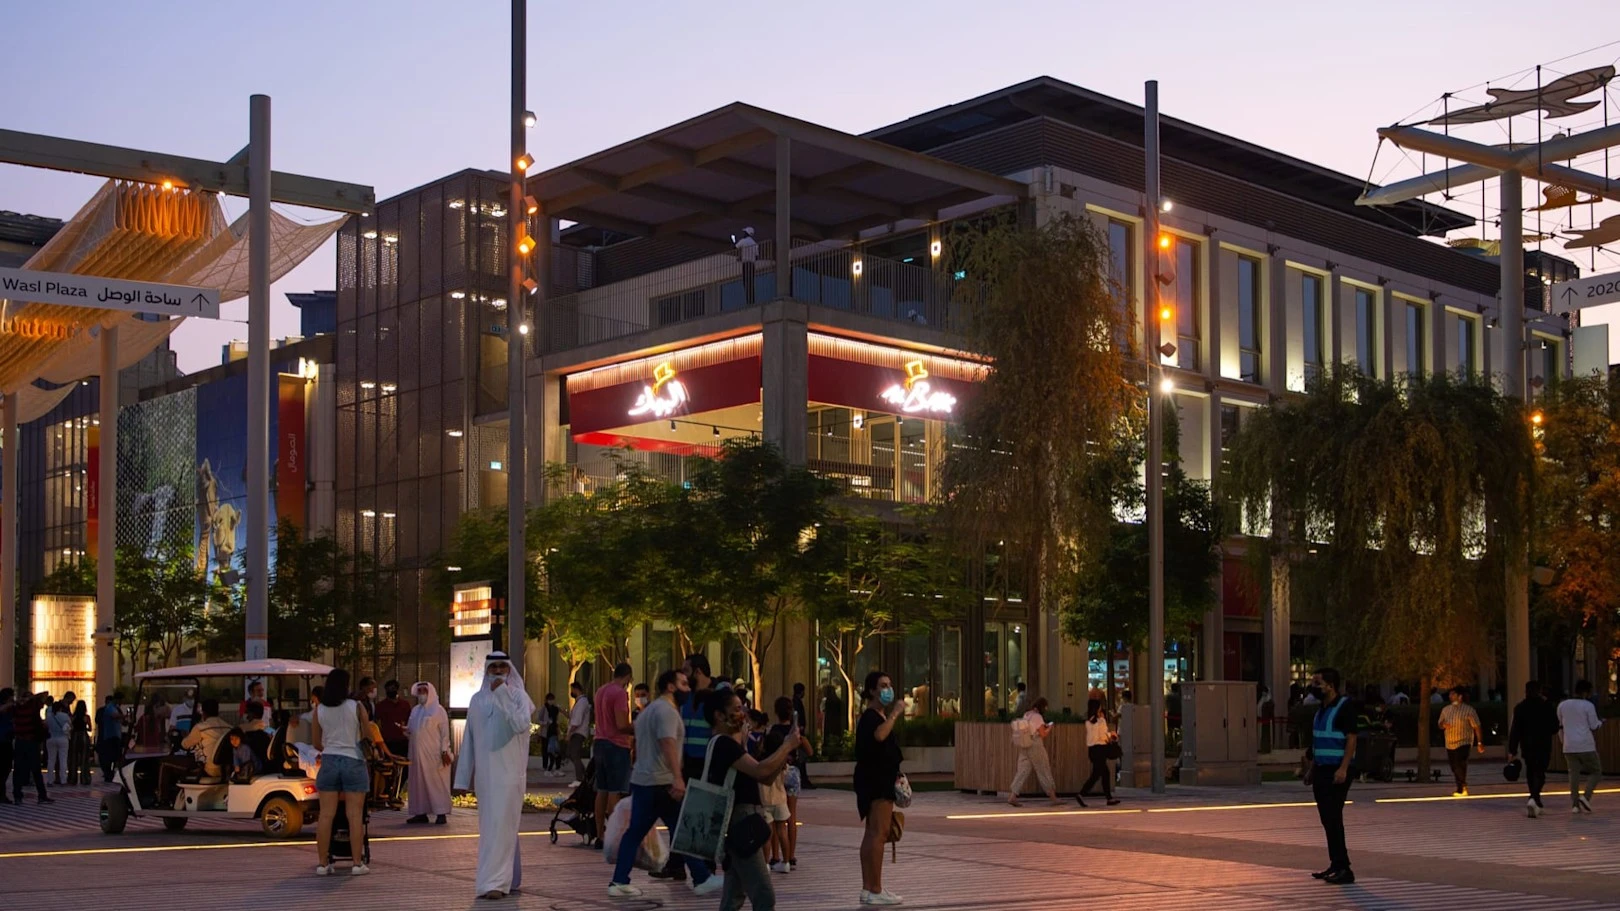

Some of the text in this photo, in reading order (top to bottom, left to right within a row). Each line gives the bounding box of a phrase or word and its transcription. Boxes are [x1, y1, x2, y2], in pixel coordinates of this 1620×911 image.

[2, 277, 88, 298] Wasl Plaza
[97, 287, 181, 306] ساحة الوصل
